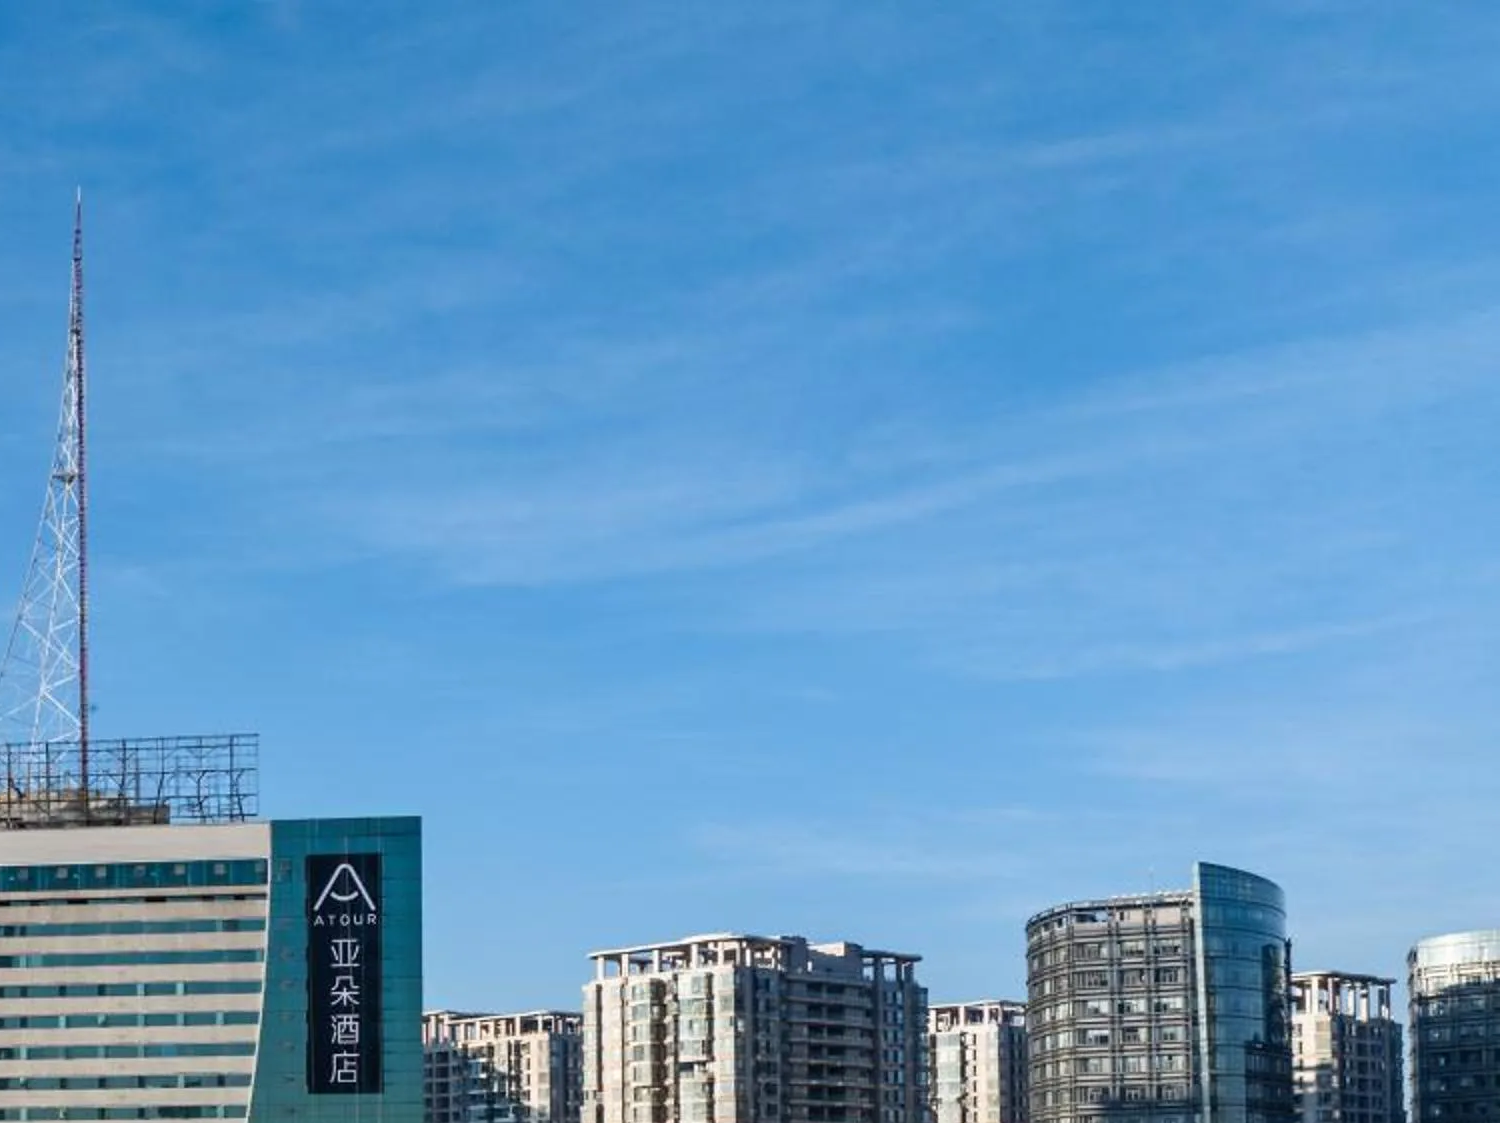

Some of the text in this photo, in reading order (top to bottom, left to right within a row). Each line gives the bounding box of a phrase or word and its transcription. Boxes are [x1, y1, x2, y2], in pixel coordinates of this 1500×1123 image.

[313, 914, 377, 927] ATOUR
[329, 938, 361, 1084] 亚朵酒店
